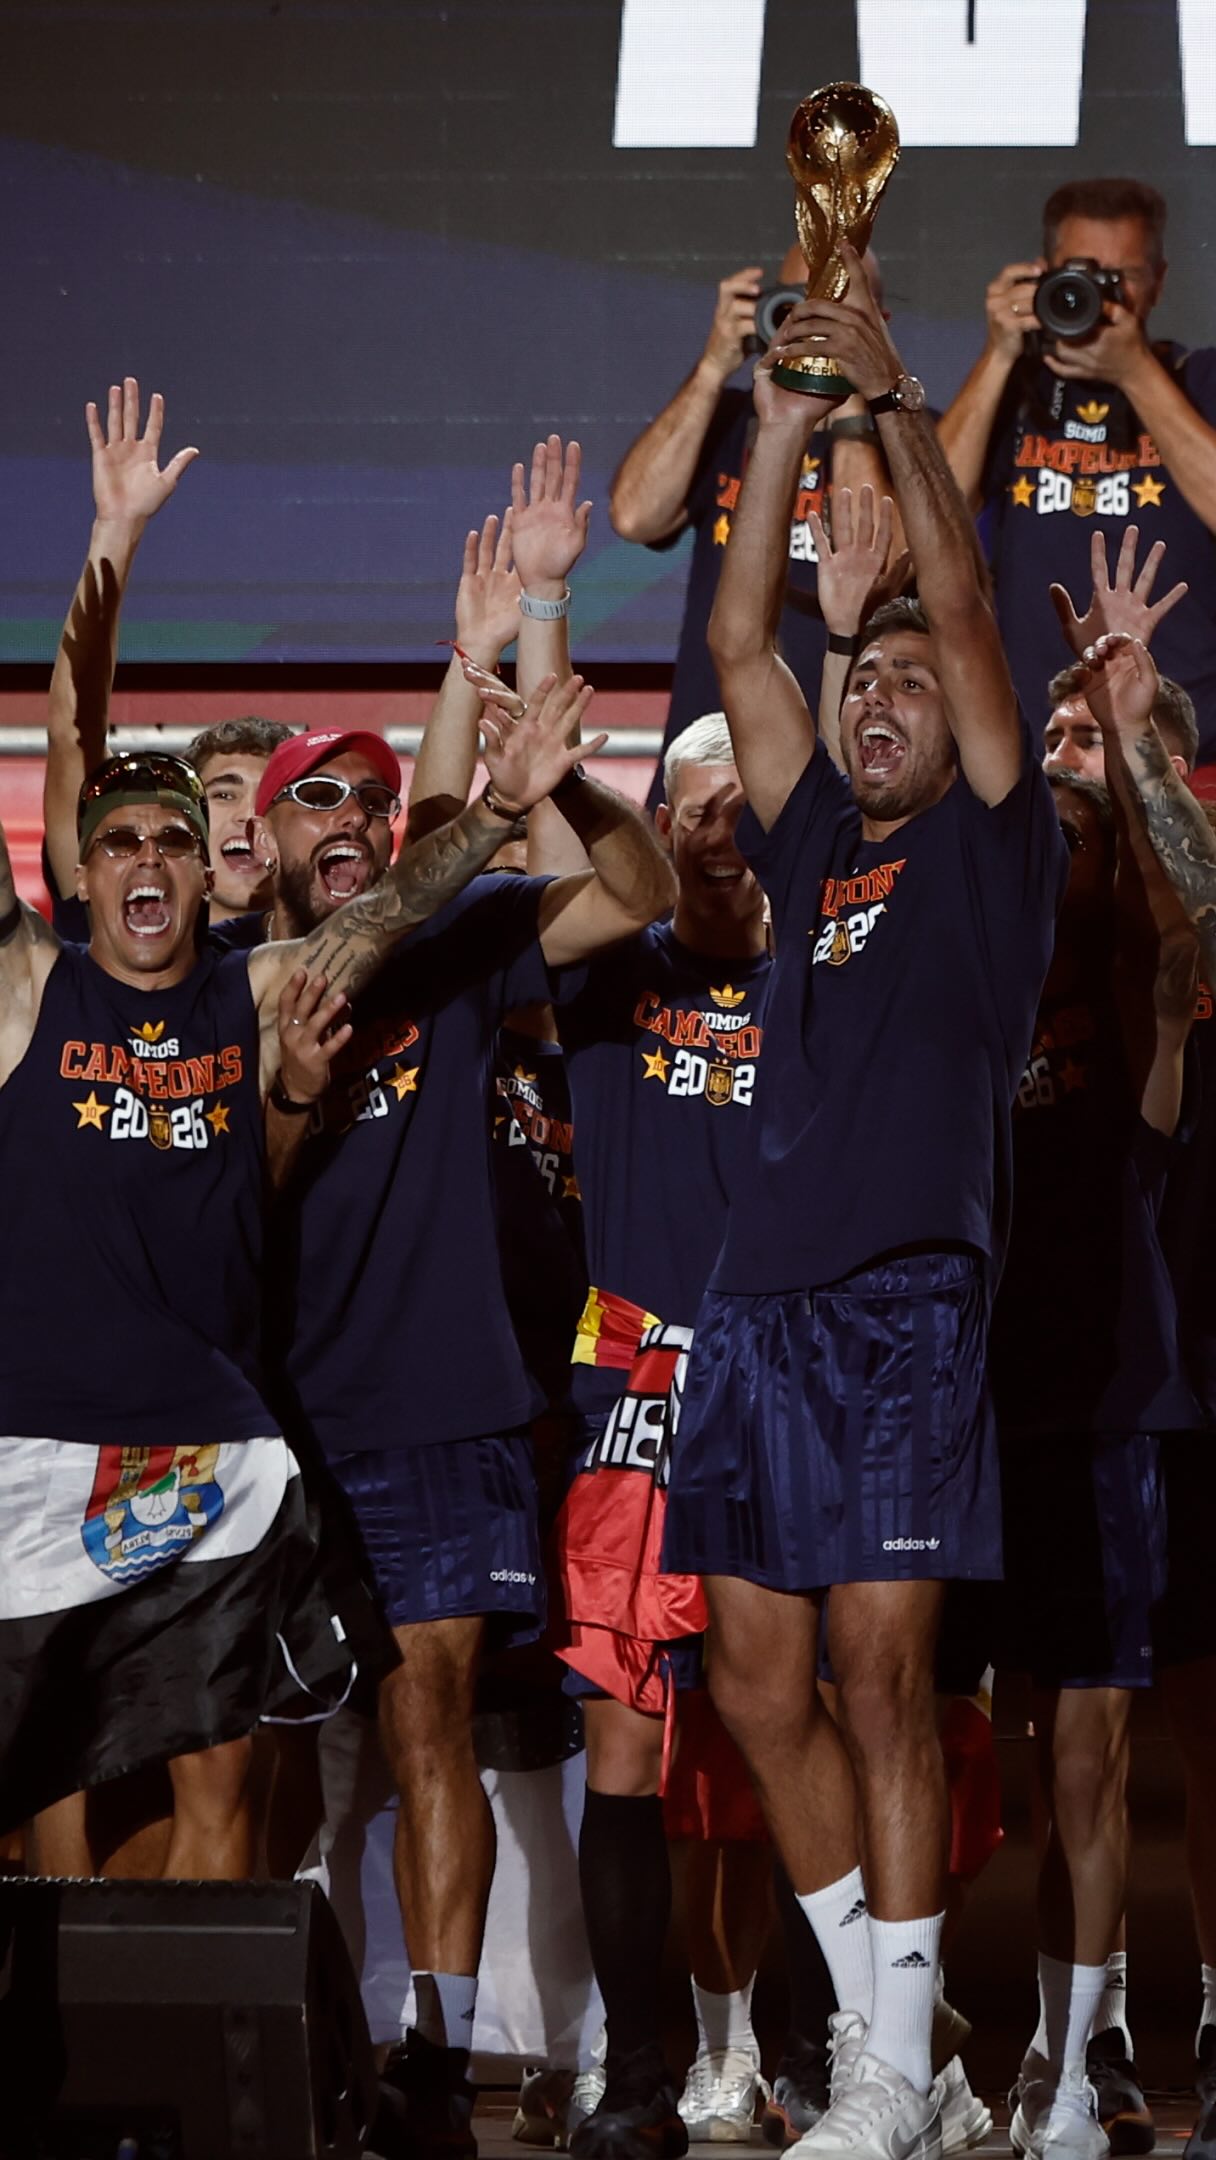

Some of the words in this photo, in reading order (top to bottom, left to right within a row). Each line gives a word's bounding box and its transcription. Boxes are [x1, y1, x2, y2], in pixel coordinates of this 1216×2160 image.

[1064, 420, 1107, 443] SOMO
[127, 1037, 180, 1059] OMOS
[883, 1537, 926, 1551] adidas
